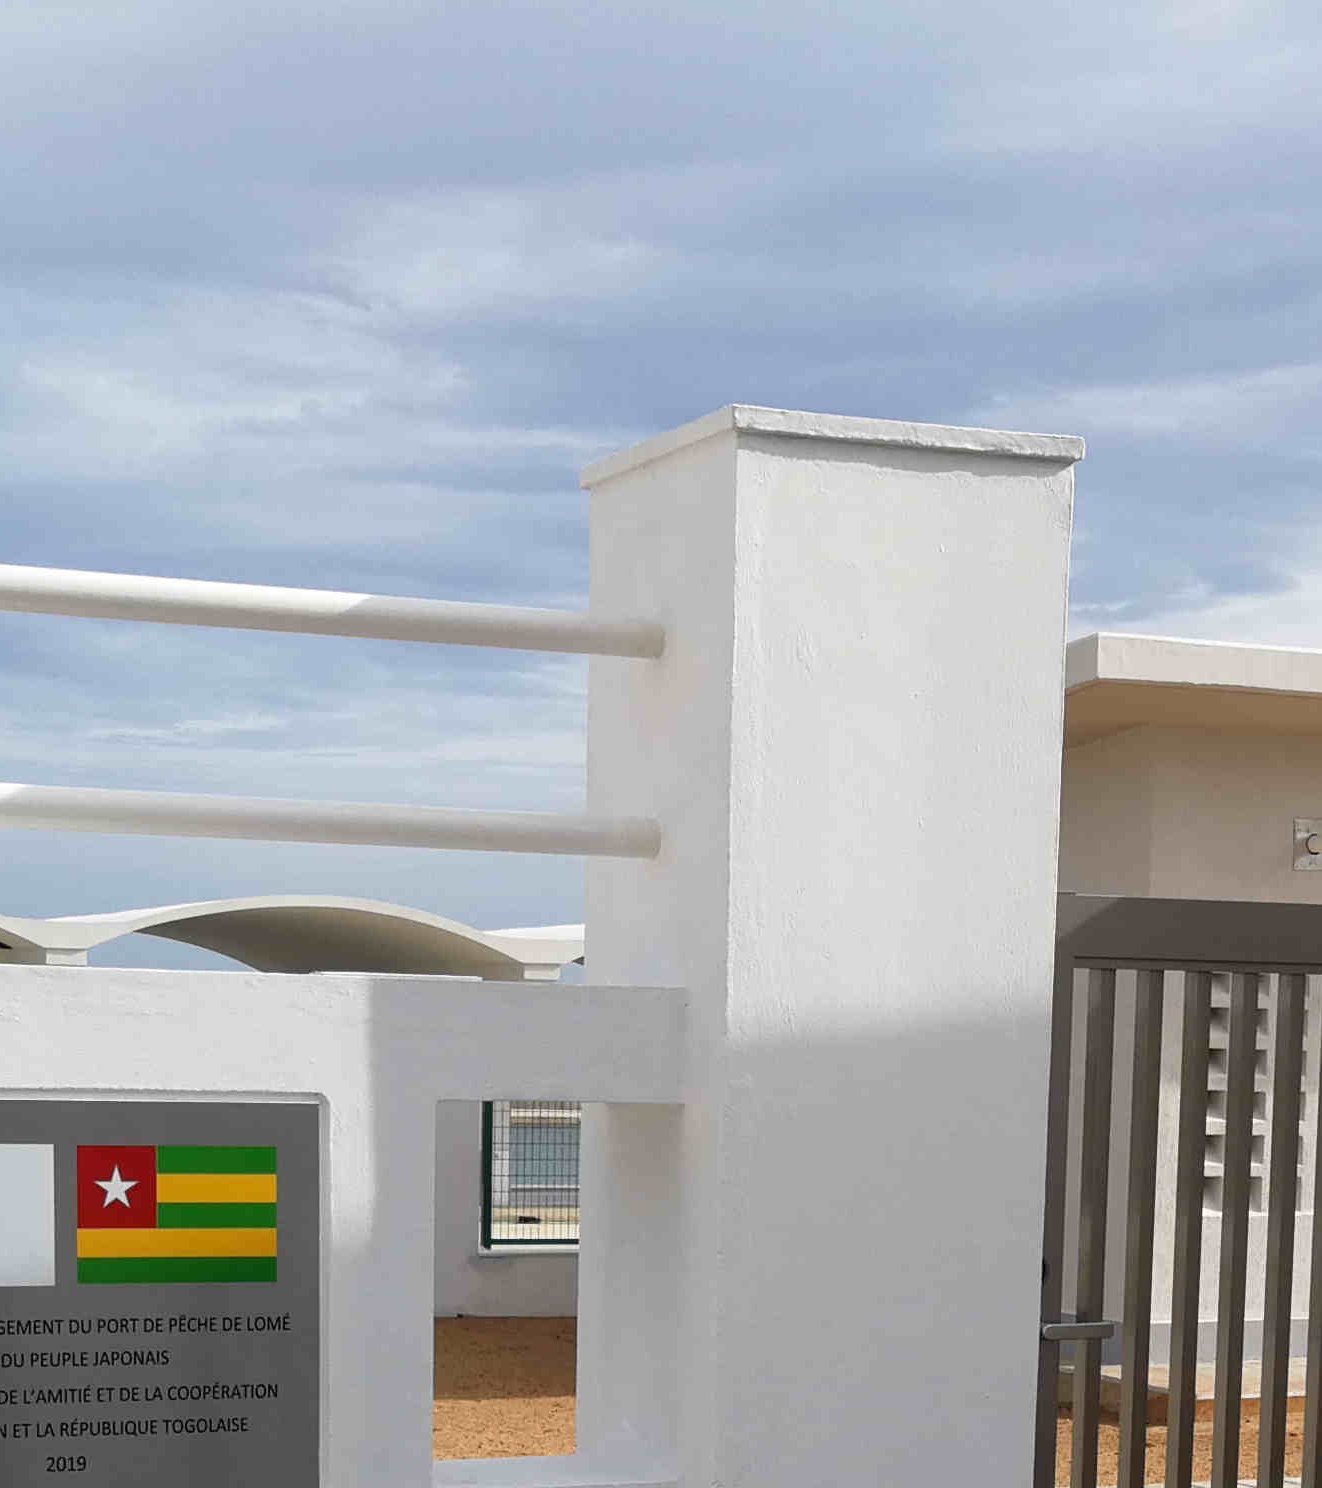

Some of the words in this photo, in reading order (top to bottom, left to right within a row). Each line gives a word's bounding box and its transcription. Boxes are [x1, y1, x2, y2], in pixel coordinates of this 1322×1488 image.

[68, 1319, 92, 1335] DU
[97, 1317, 140, 1334] PORT
[143, 1317, 164, 1333] DE
[168, 1314, 218, 1334] PÊCHE
[222, 1316, 243, 1332] DE
[246, 1312, 292, 1332] LOMÉ
[0, 1352, 25, 1369] DU
[30, 1351, 89, 1368] PEUPLE
[92, 1349, 170, 1367] JAPONAIS
[96, 1387, 116, 1403] ET
[119, 1386, 141, 1402] DE
[144, 1386, 164, 1402] LA
[167, 1381, 278, 1401] COOPÉRATION
[12, 1423, 33, 1439] ET
[36, 1422, 56, 1439] LA
[59, 1417, 158, 1438] RÉPUBLIQUE
[162, 1416, 249, 1435] TOGOLAISE
[46, 1455, 87, 1473] 2019
